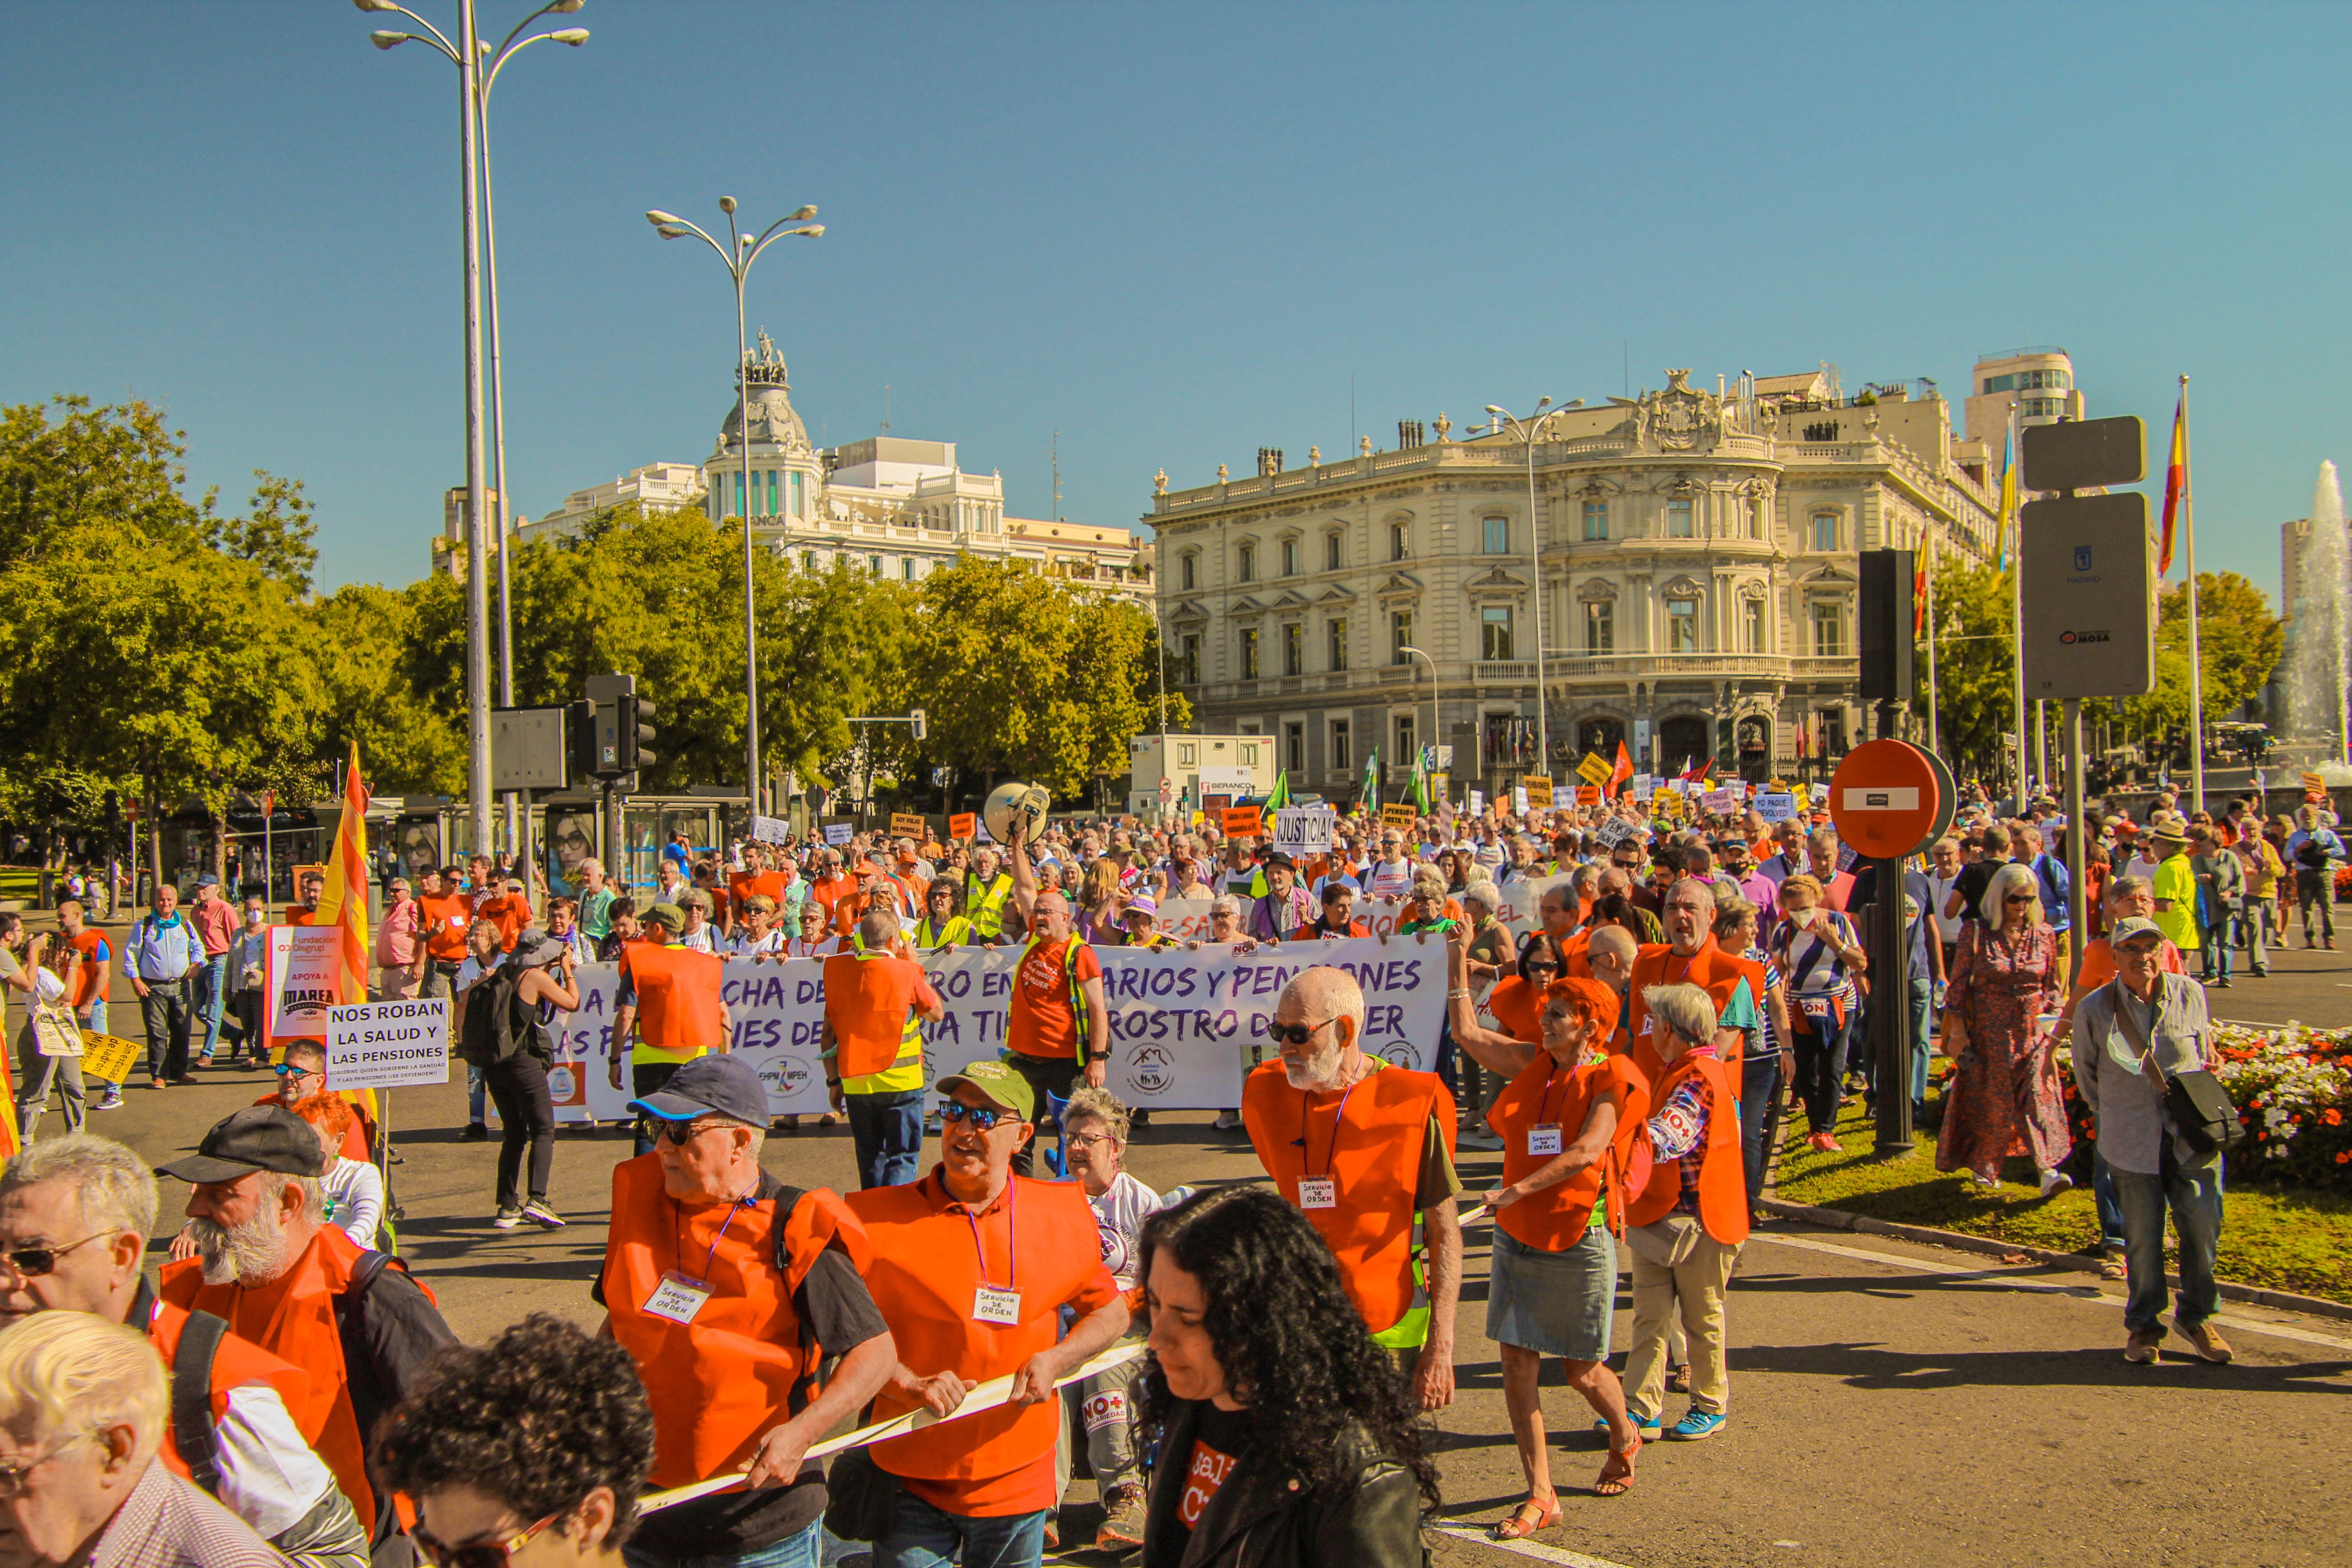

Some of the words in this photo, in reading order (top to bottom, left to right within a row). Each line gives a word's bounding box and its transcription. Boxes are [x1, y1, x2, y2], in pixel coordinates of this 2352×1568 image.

[2078, 634, 2110, 643] MOSA
[1277, 817, 1331, 843] ¡JUSTICIA!
[293, 945, 324, 953] Disgrup
[1207, 970, 1226, 998] Y
[284, 990, 334, 1007] MAREA
[332, 1008, 371, 1023] NOS
[378, 1003, 443, 1019] ROBAN
[1106, 1009, 1239, 1042] ROSTRO
[108, 1039, 120, 1049] de
[338, 1033, 358, 1045] LA
[364, 1028, 421, 1043] SALUD
[427, 1026, 438, 1038] Y
[123, 1044, 136, 1054] Sin
[333, 1054, 358, 1064] LAS
[363, 1047, 442, 1062] PENSIONES
[108, 1054, 127, 1079] excusas
[787, 1071, 807, 1080] MPEH
[656, 1300, 687, 1313] ORDEN
[981, 1306, 1012, 1316] ORDEN
